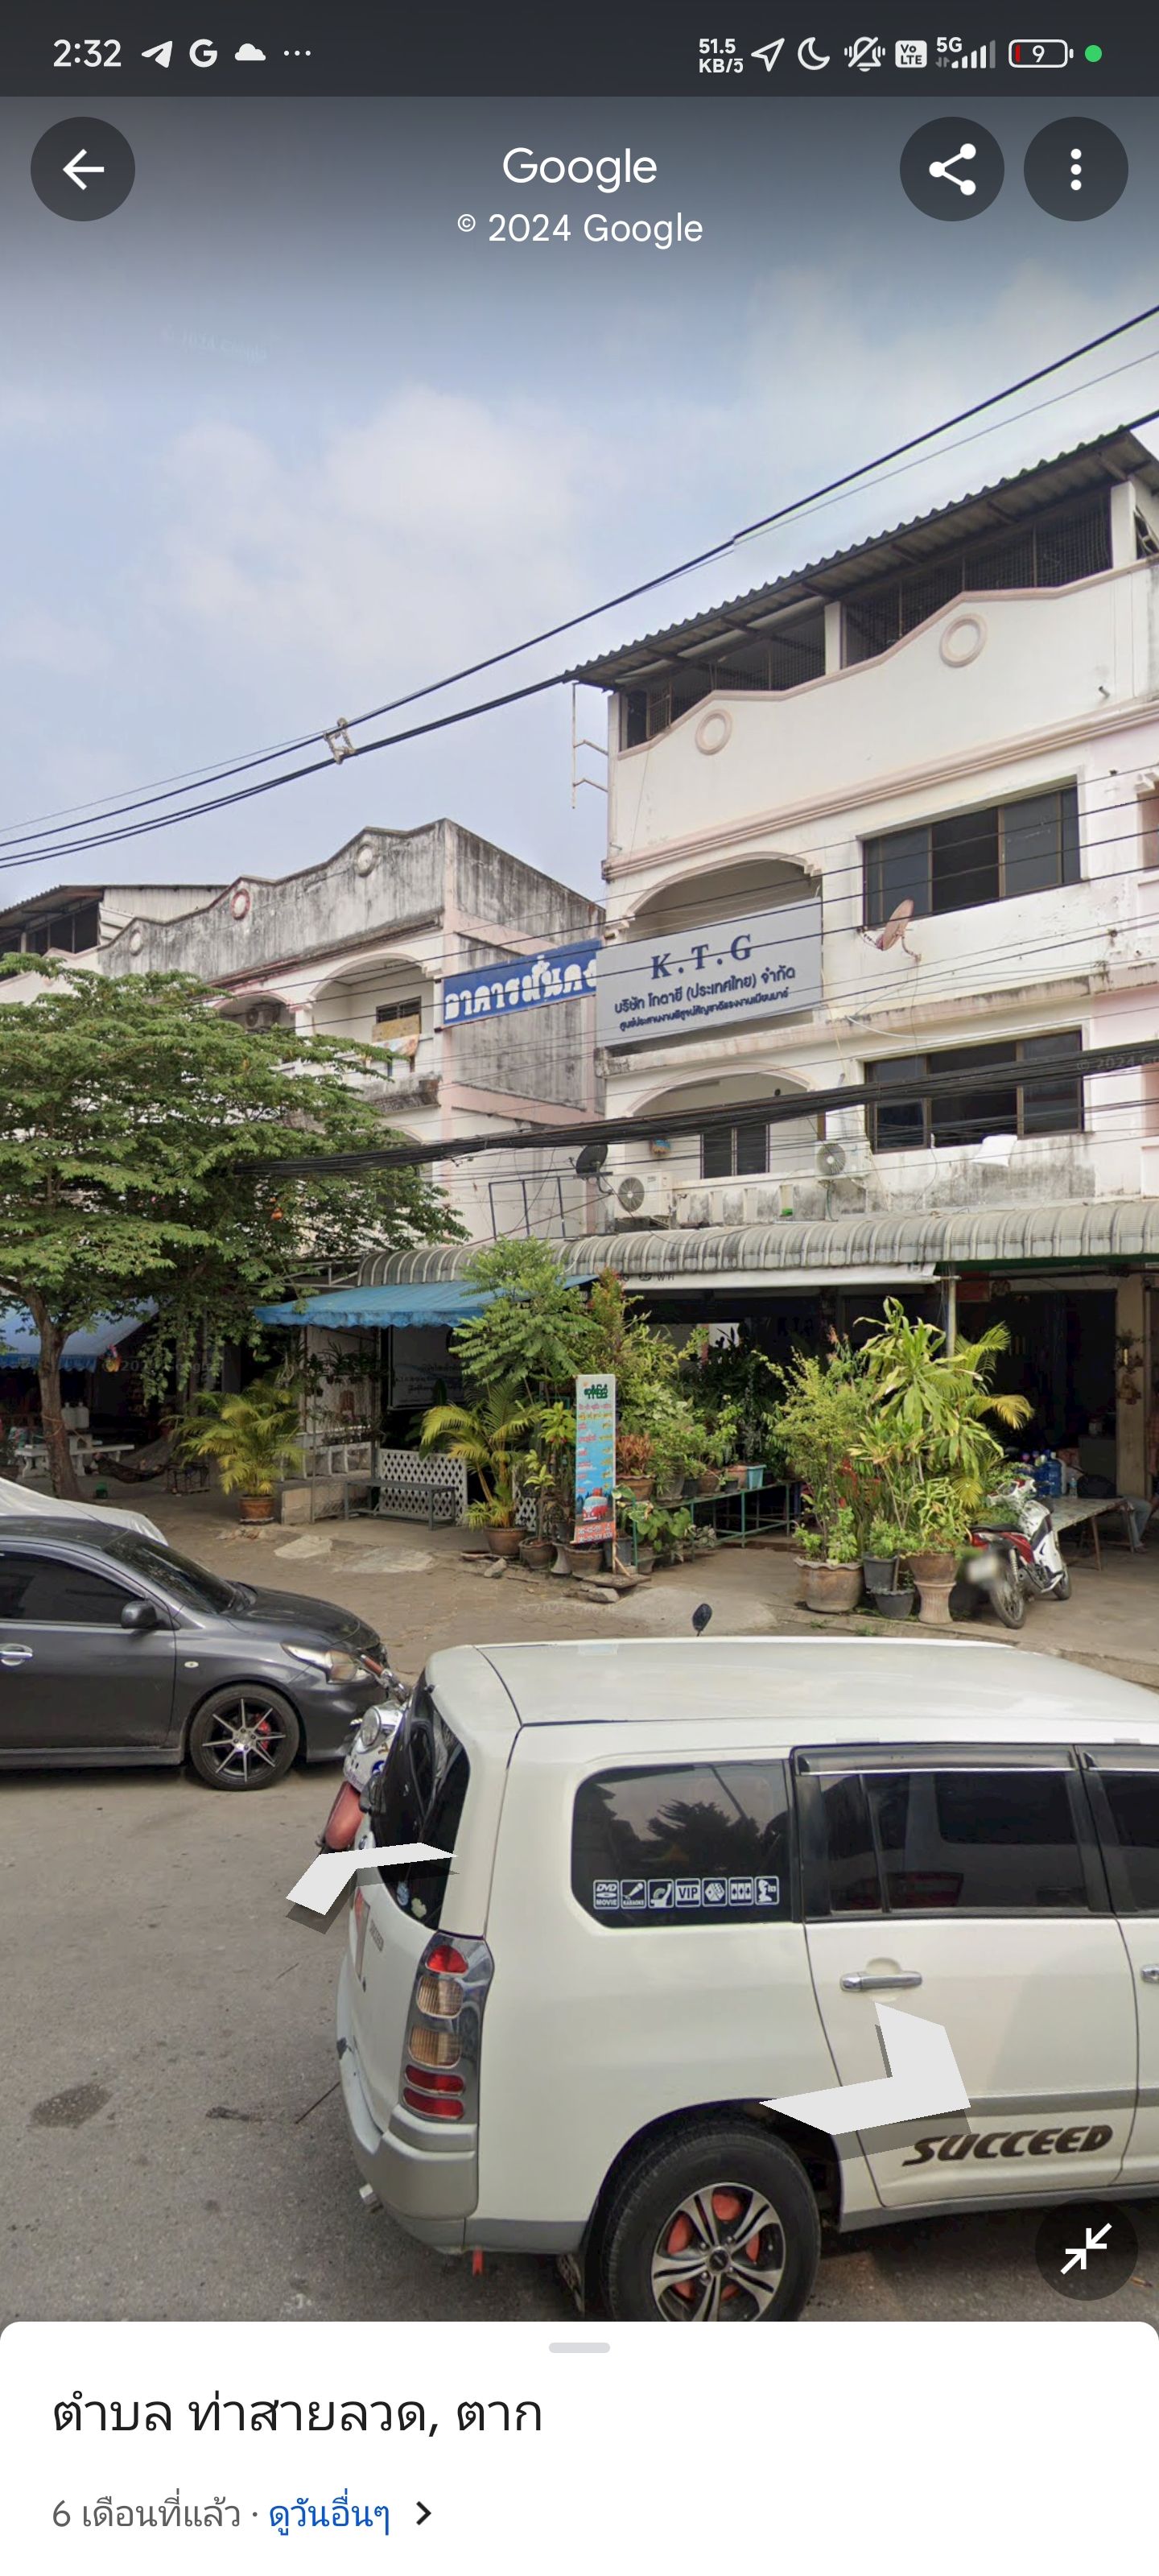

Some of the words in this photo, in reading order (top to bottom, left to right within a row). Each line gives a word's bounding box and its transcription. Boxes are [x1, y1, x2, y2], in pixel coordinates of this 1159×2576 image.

[614, 997, 645, 1014] บริษัท
[686, 974, 757, 1002] (ประเทศไทย)
[760, 964, 796, 985] จำกัด
[596, 1883, 617, 1893] DVD
[678, 1887, 699, 1900] VIP
[596, 1898, 618, 1906] MOVIE
[901, 2124, 1113, 2167] SUCCEED
